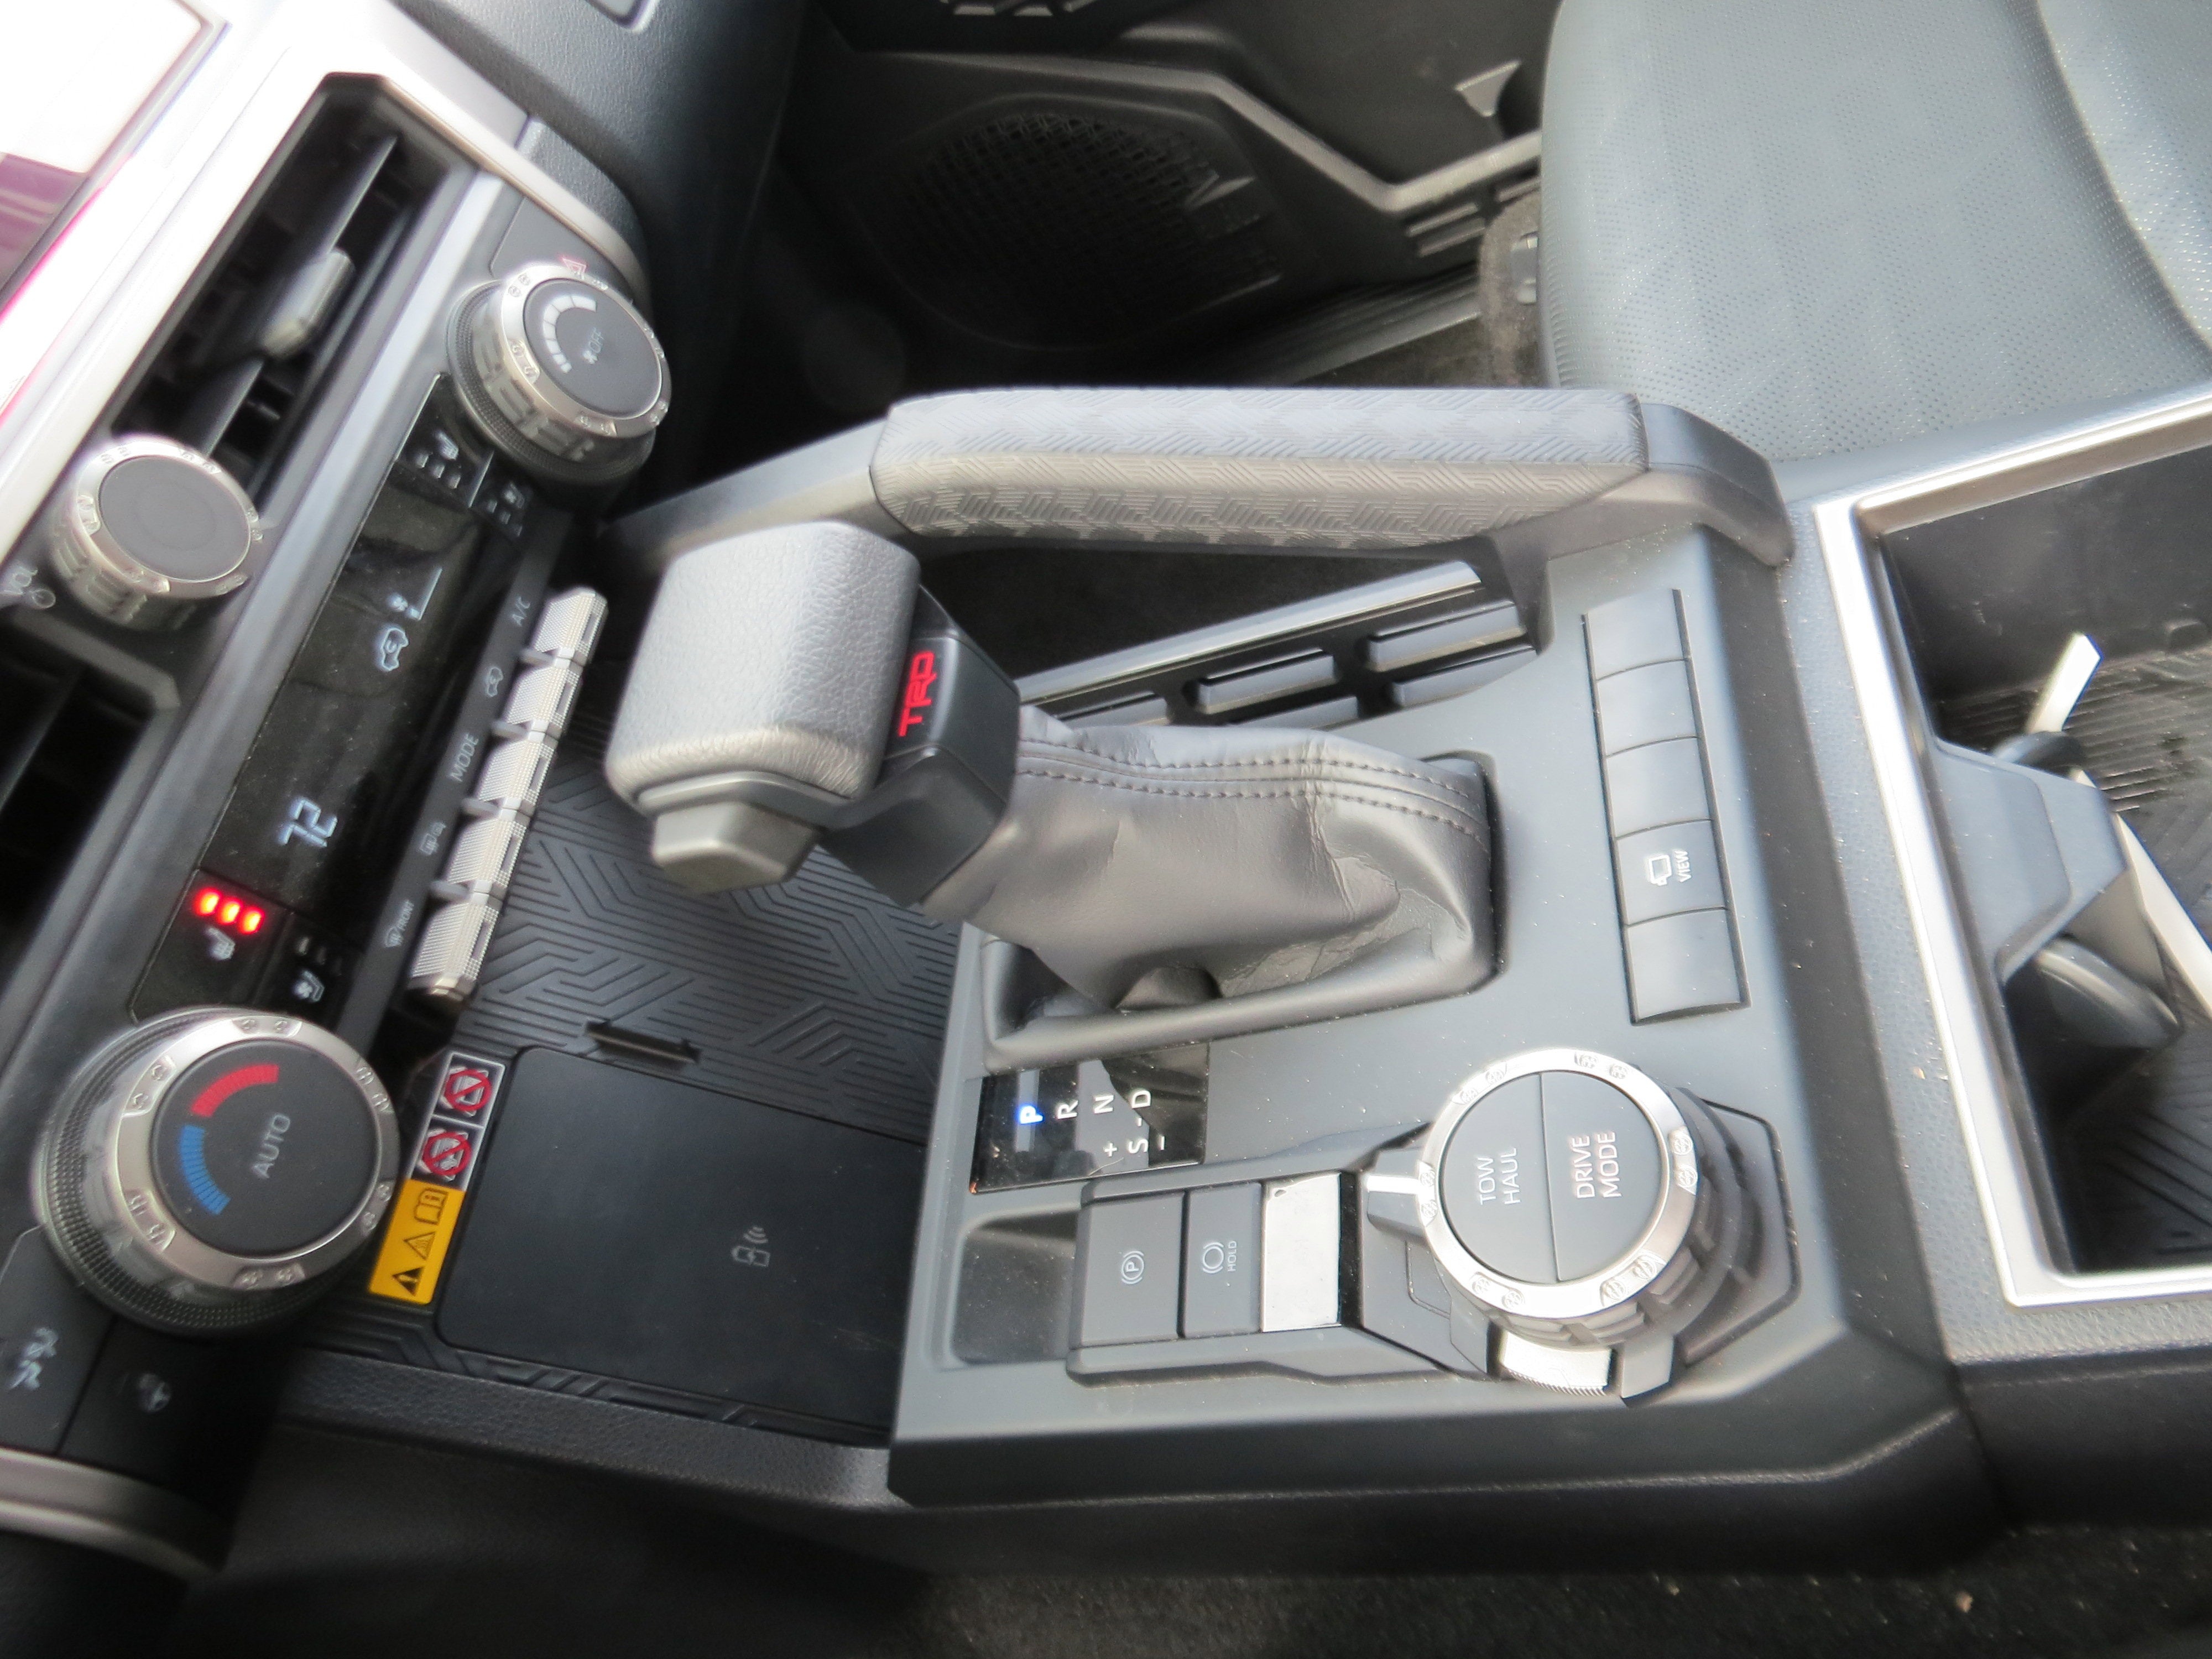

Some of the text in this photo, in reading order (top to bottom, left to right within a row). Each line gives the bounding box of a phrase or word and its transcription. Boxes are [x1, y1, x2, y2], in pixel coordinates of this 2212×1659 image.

[588, 327, 604, 353] OFF
[511, 597, 531, 627] A/C
[449, 734, 479, 782] MODE
[277, 796, 338, 847] 72
[1676, 850, 1693, 883] VIEW
[1057, 1100, 1078, 1120] R
[1094, 1095, 1114, 1114] N
[1131, 1089, 1151, 1109] D
[1019, 1106, 1044, 1125] P
[251, 1114, 291, 1179] AUTO
[1129, 1138, 1149, 1154] S
[1503, 1147, 1521, 1204] HAUL
[1572, 1135, 1596, 1199] DRIVE
[1596, 1131, 1623, 1198] MODE
[1479, 1156, 1496, 1206] TOW
[1227, 1240, 1237, 1271] HOLD
